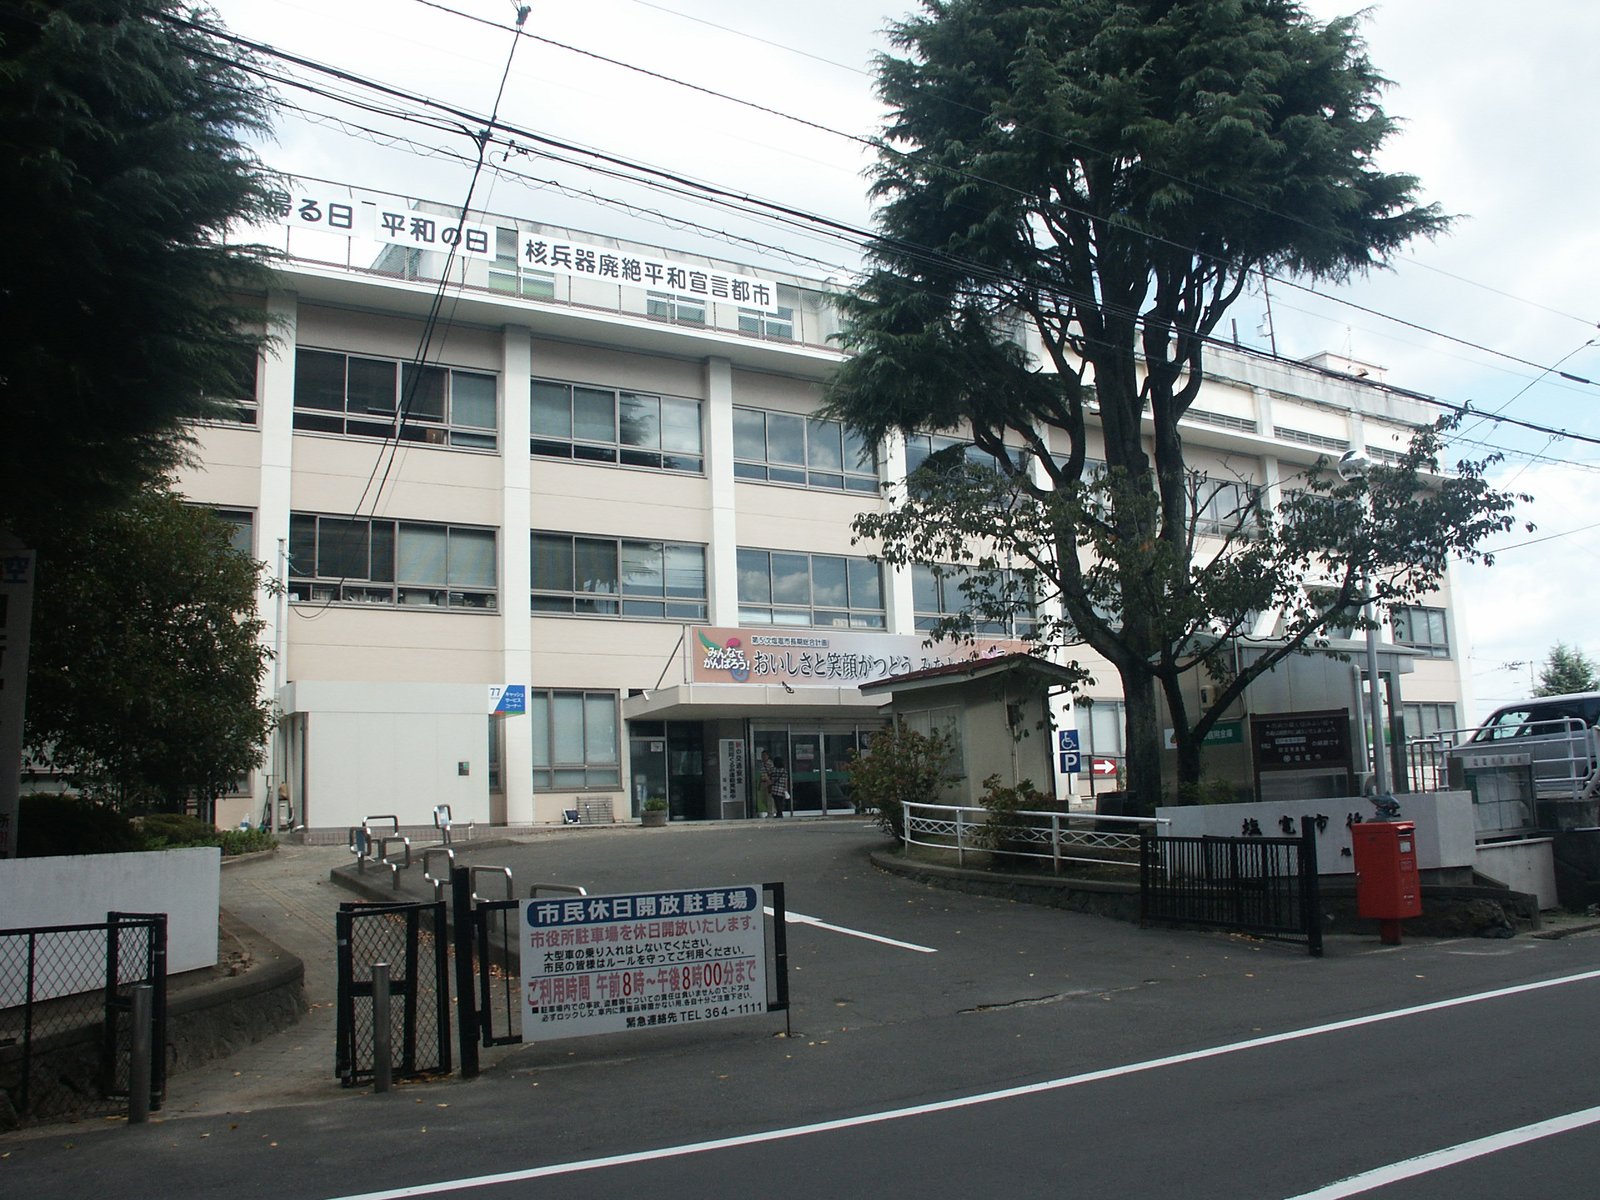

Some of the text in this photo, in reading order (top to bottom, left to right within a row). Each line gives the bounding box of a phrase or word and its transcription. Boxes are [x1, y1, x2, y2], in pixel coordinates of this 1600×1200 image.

[381, 211, 488, 254] 平和の日
[525, 239, 770, 306] 核兵器廃絶平和宣言都市
[707, 647, 744, 659] みんなで
[753, 651, 912, 680] おいしさと笑顔がつどう
[490, 687, 501, 697] 77
[1064, 753, 1077, 771] P
[537, 890, 748, 925] 市民休日開放駐車場
[527, 974, 591, 1006] ご利用時間
[626, 1002, 763, 1029] 緊急連絡先 TEL 364-1111
